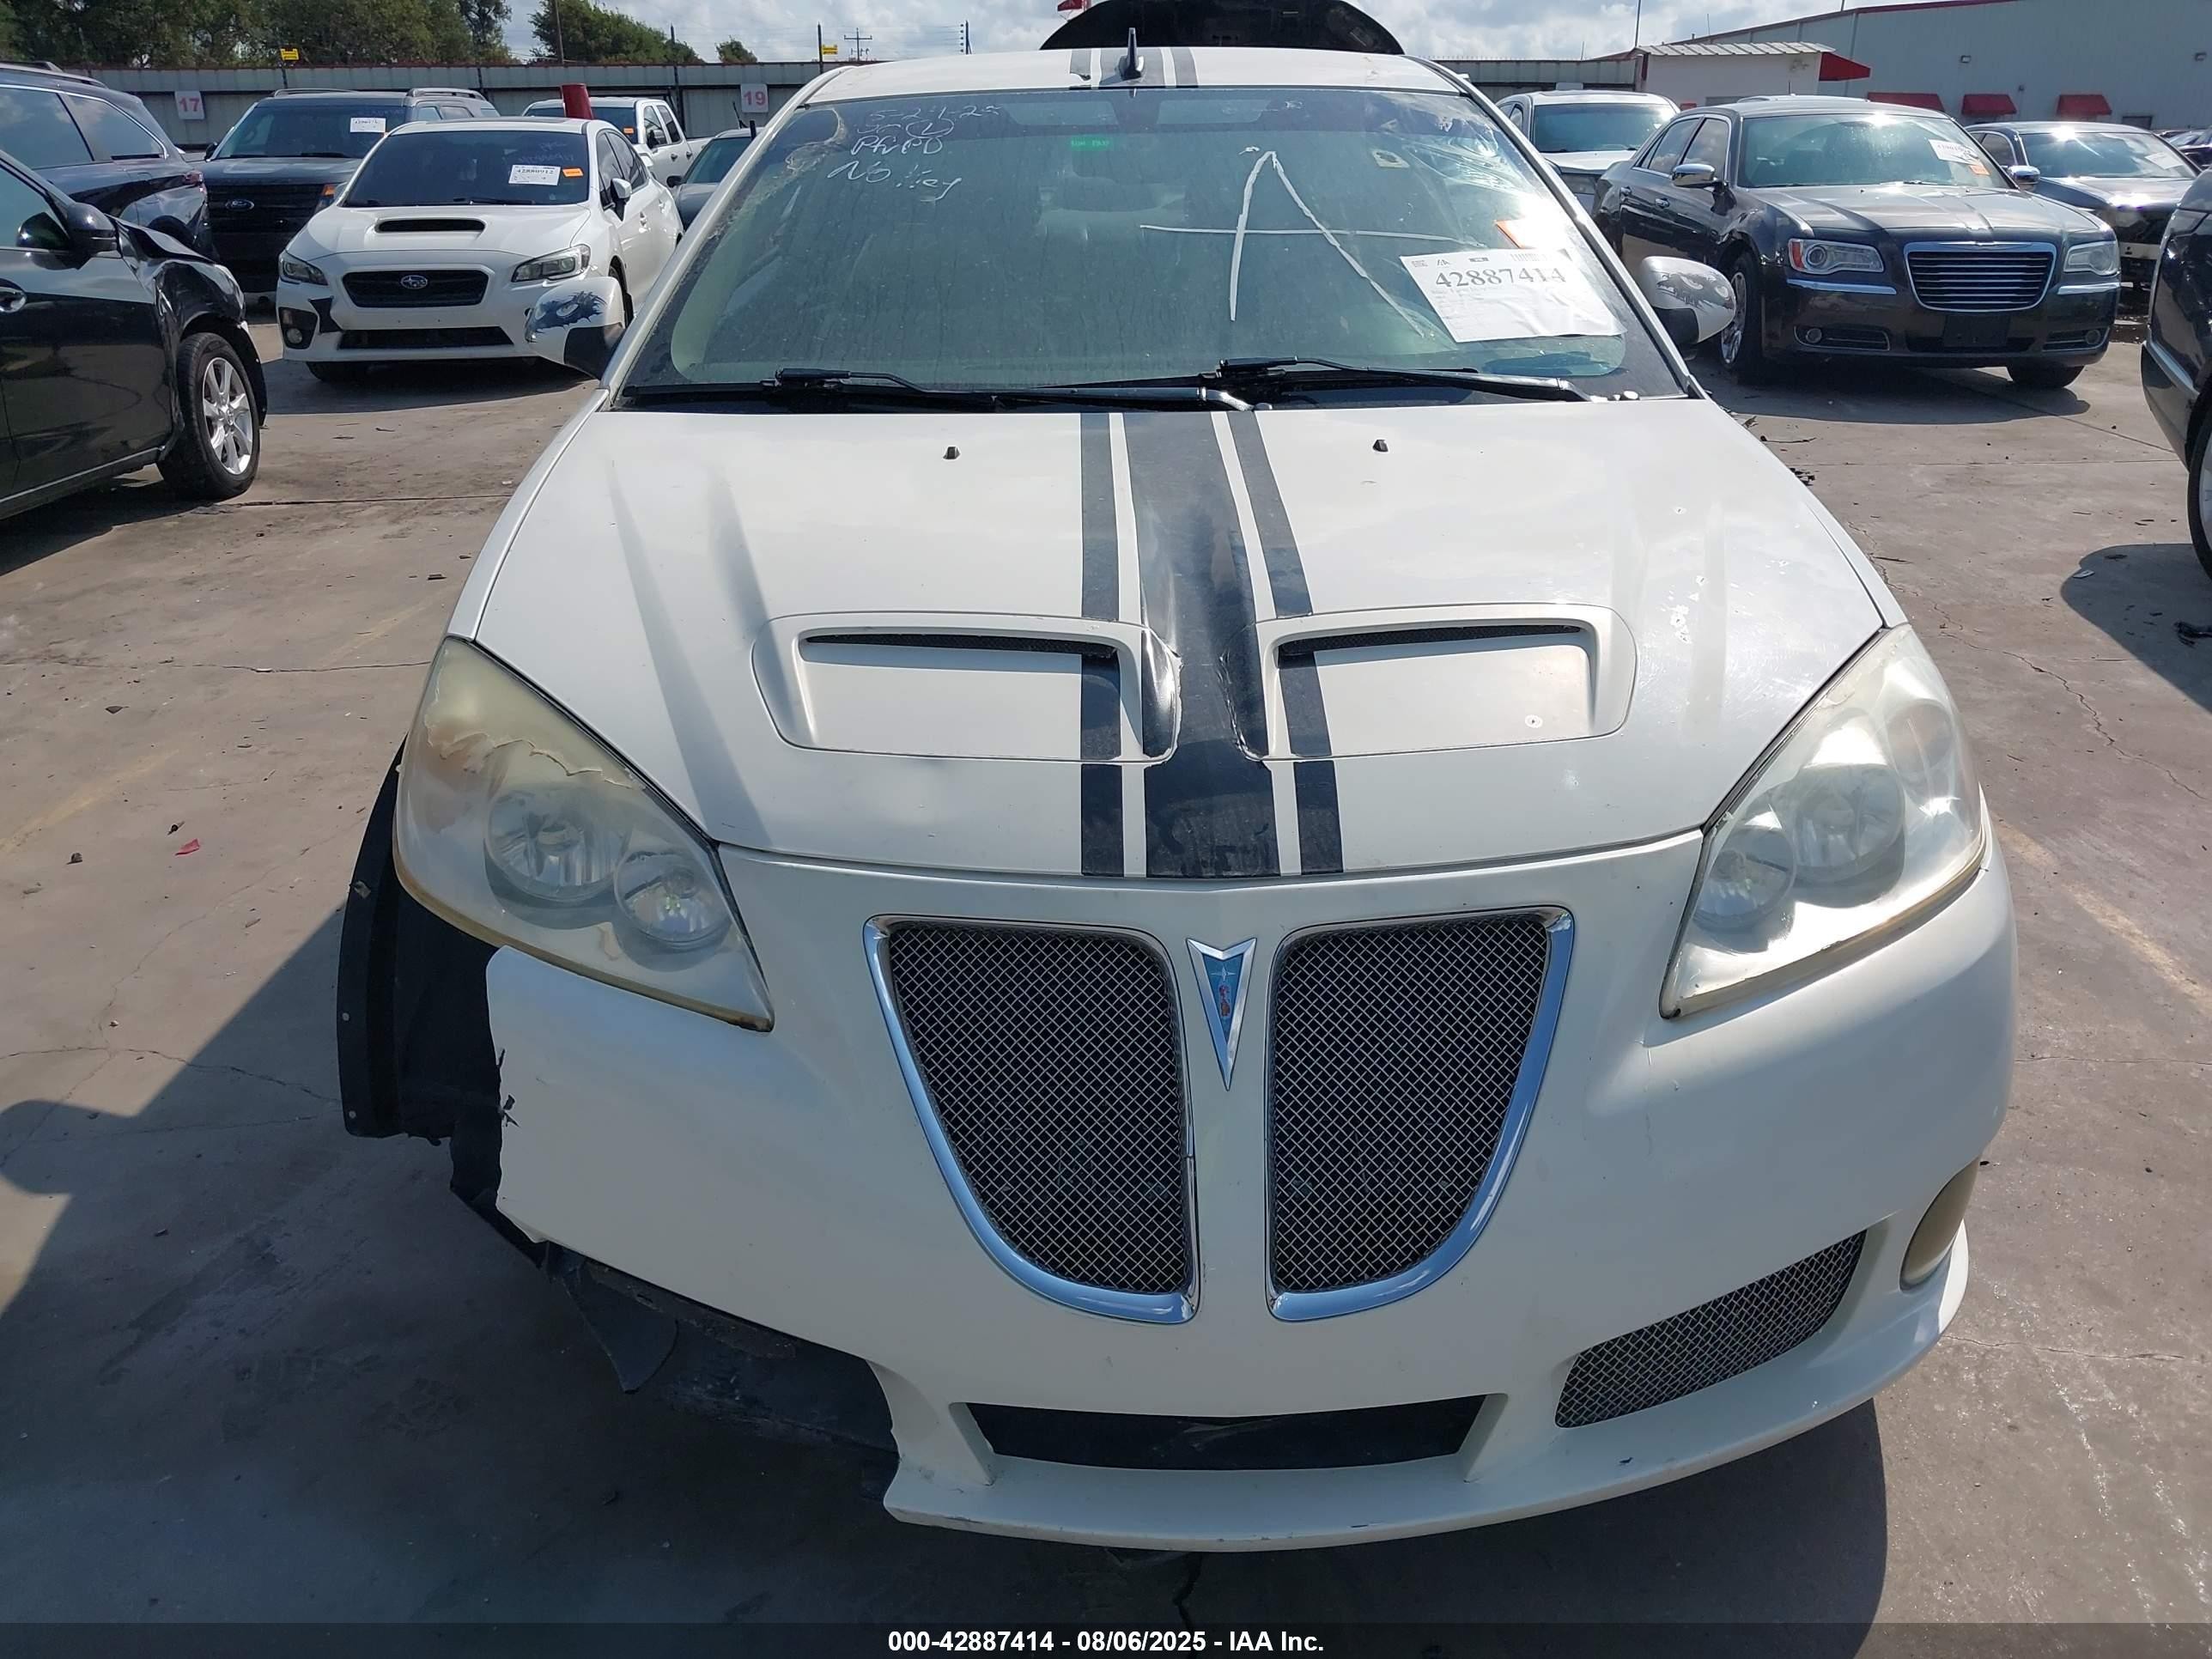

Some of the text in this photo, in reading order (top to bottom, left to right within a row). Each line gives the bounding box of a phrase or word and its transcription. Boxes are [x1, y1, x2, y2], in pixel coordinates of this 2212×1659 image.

[179, 97, 200, 112] 17
[744, 90, 766, 106] 19
[1435, 267, 1567, 288] 42887414
